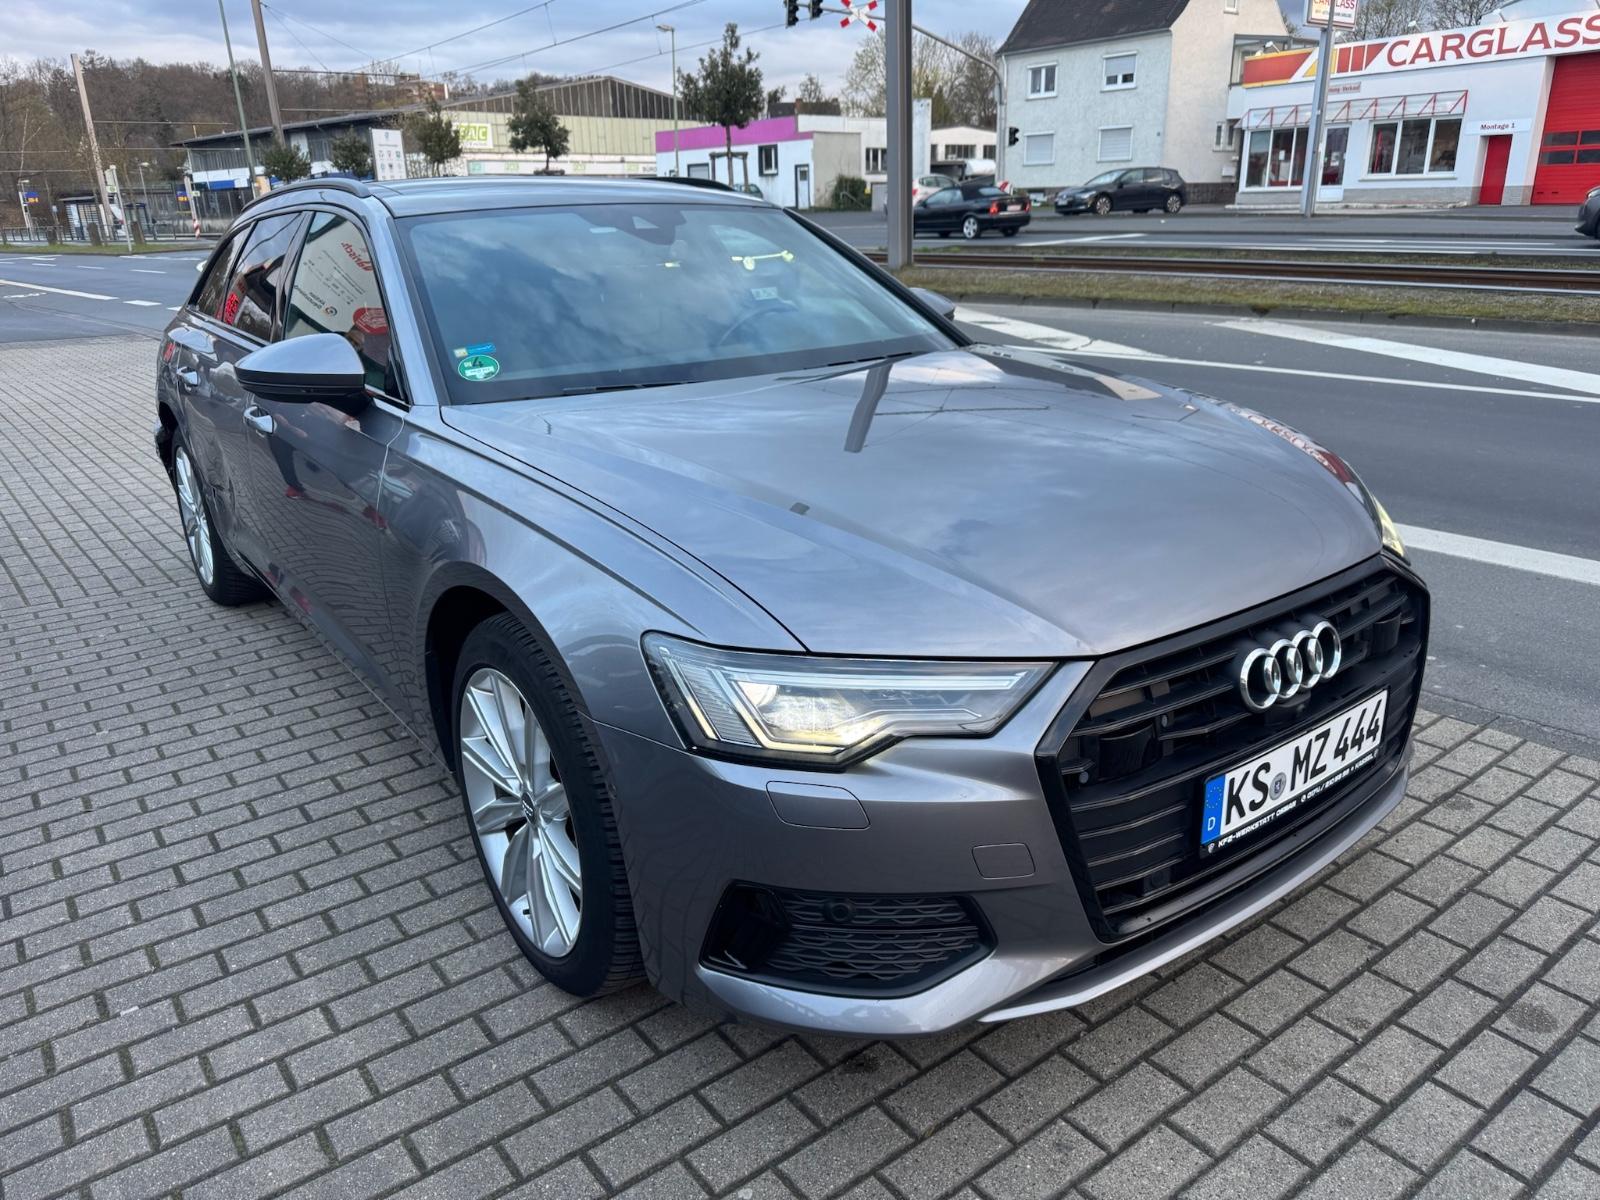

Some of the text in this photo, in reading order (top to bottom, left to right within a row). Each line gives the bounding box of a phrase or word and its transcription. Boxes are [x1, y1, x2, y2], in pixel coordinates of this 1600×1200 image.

[1481, 122, 1509, 130] Montage
[1225, 698, 1382, 826] KS MZ 444
[1207, 816, 1216, 831] D
